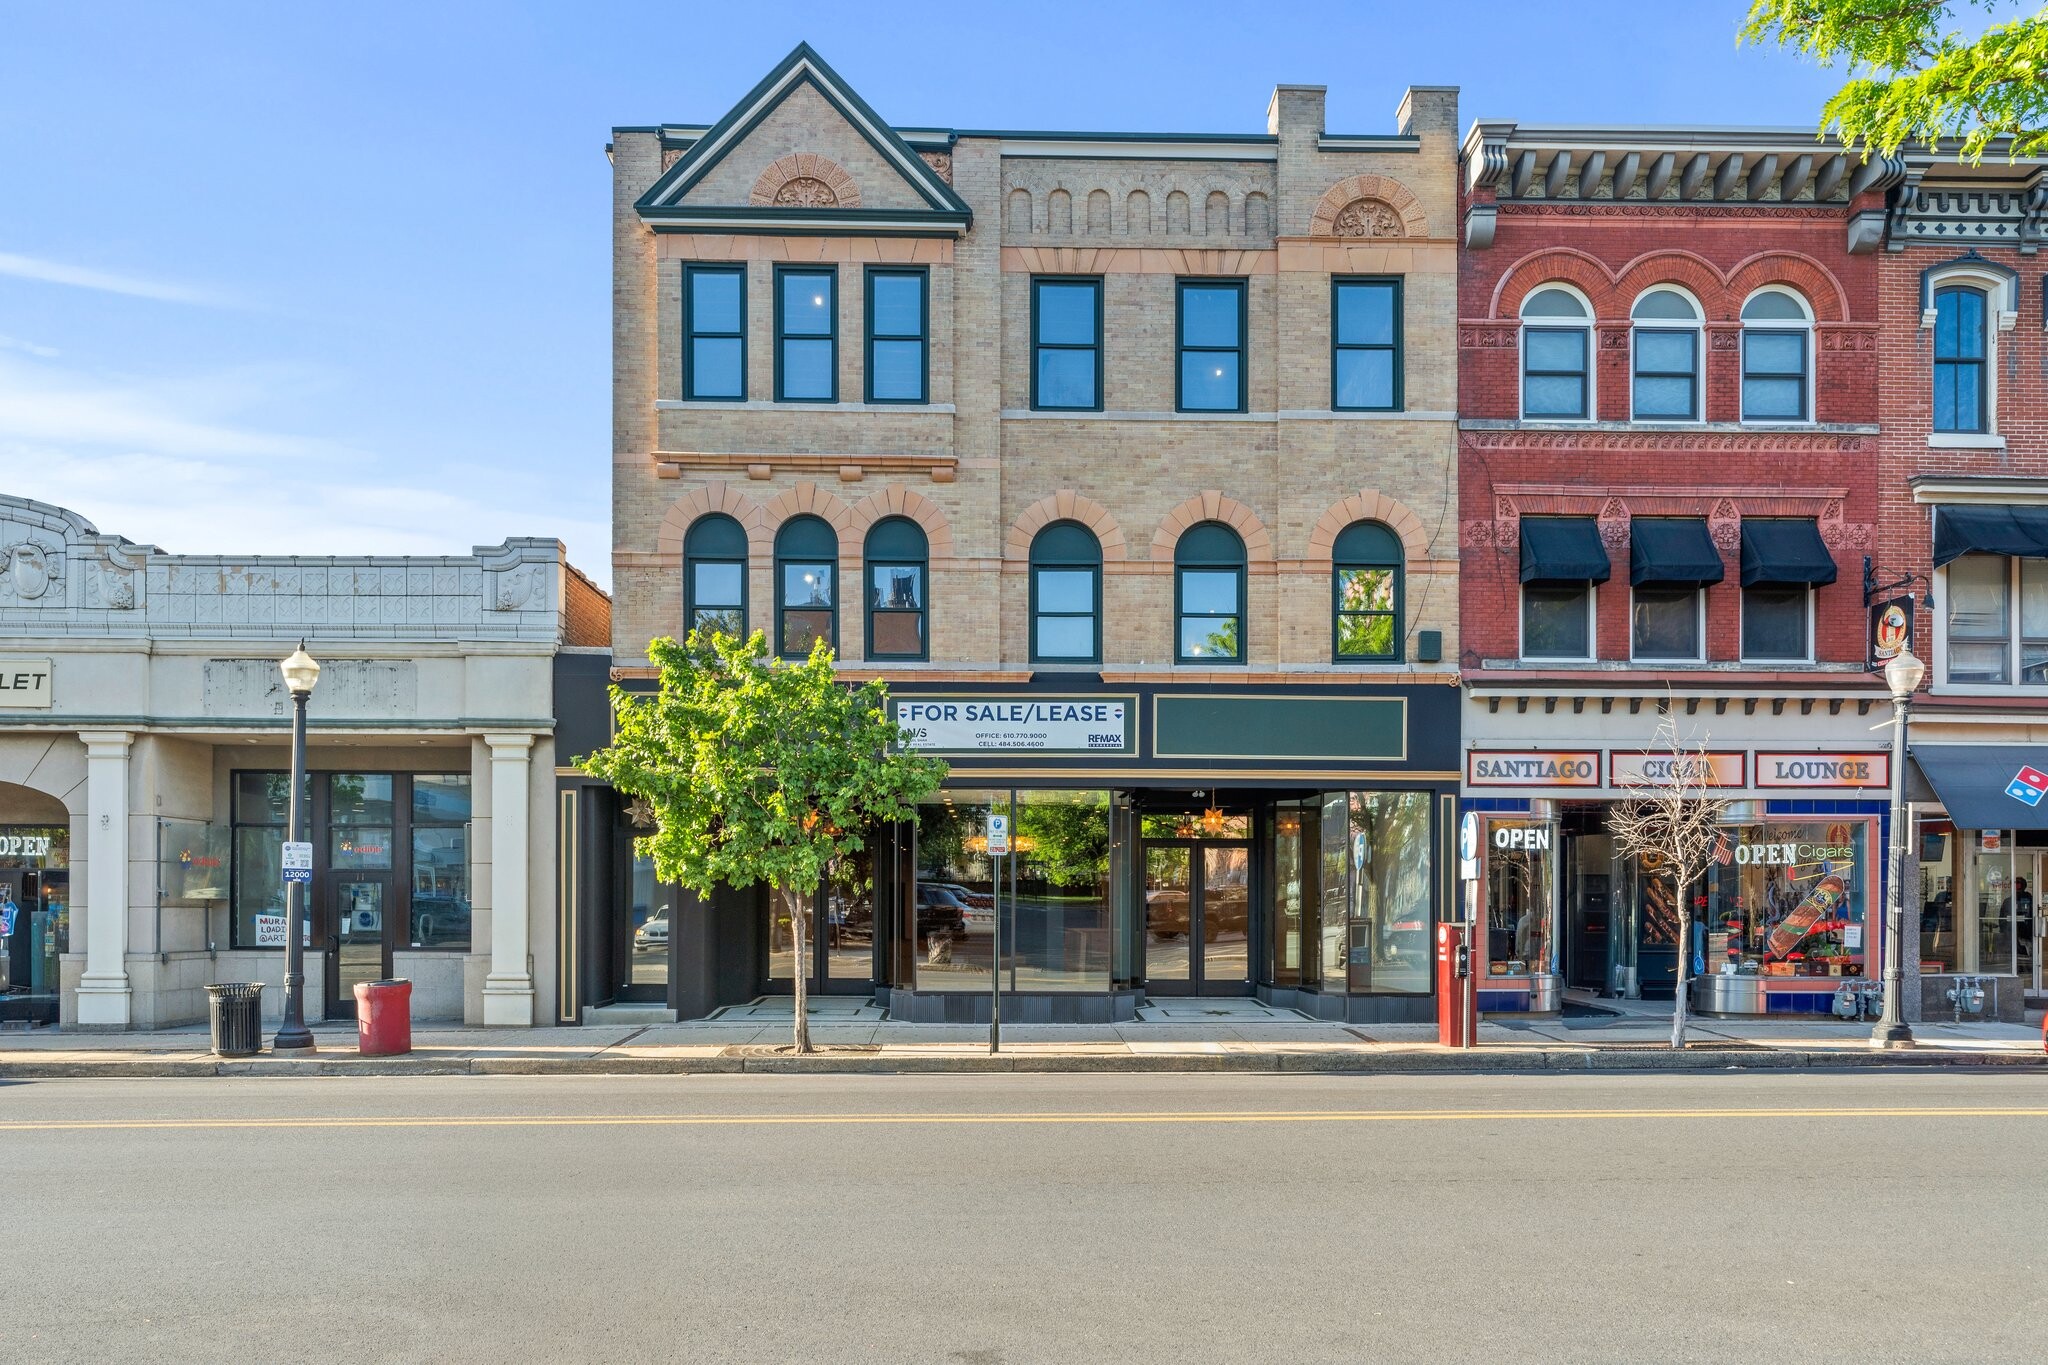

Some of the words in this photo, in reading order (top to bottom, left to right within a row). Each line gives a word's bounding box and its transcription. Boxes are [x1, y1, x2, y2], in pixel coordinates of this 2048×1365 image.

[911, 705, 958, 721] FOR
[966, 703, 1108, 724] SALE/LEASE
[1476, 760, 1593, 779] SANTIAGO
[1775, 761, 1870, 780] LOUNGE
[0, 836, 51, 856] OPEN
[1495, 828, 1549, 850] OPEN
[1734, 844, 1797, 865] OPEN
[1798, 844, 1854, 861] Cigars
[285, 871, 310, 879] 12000
[259, 917, 287, 925] MURA
[260, 925, 287, 933] LOADI
